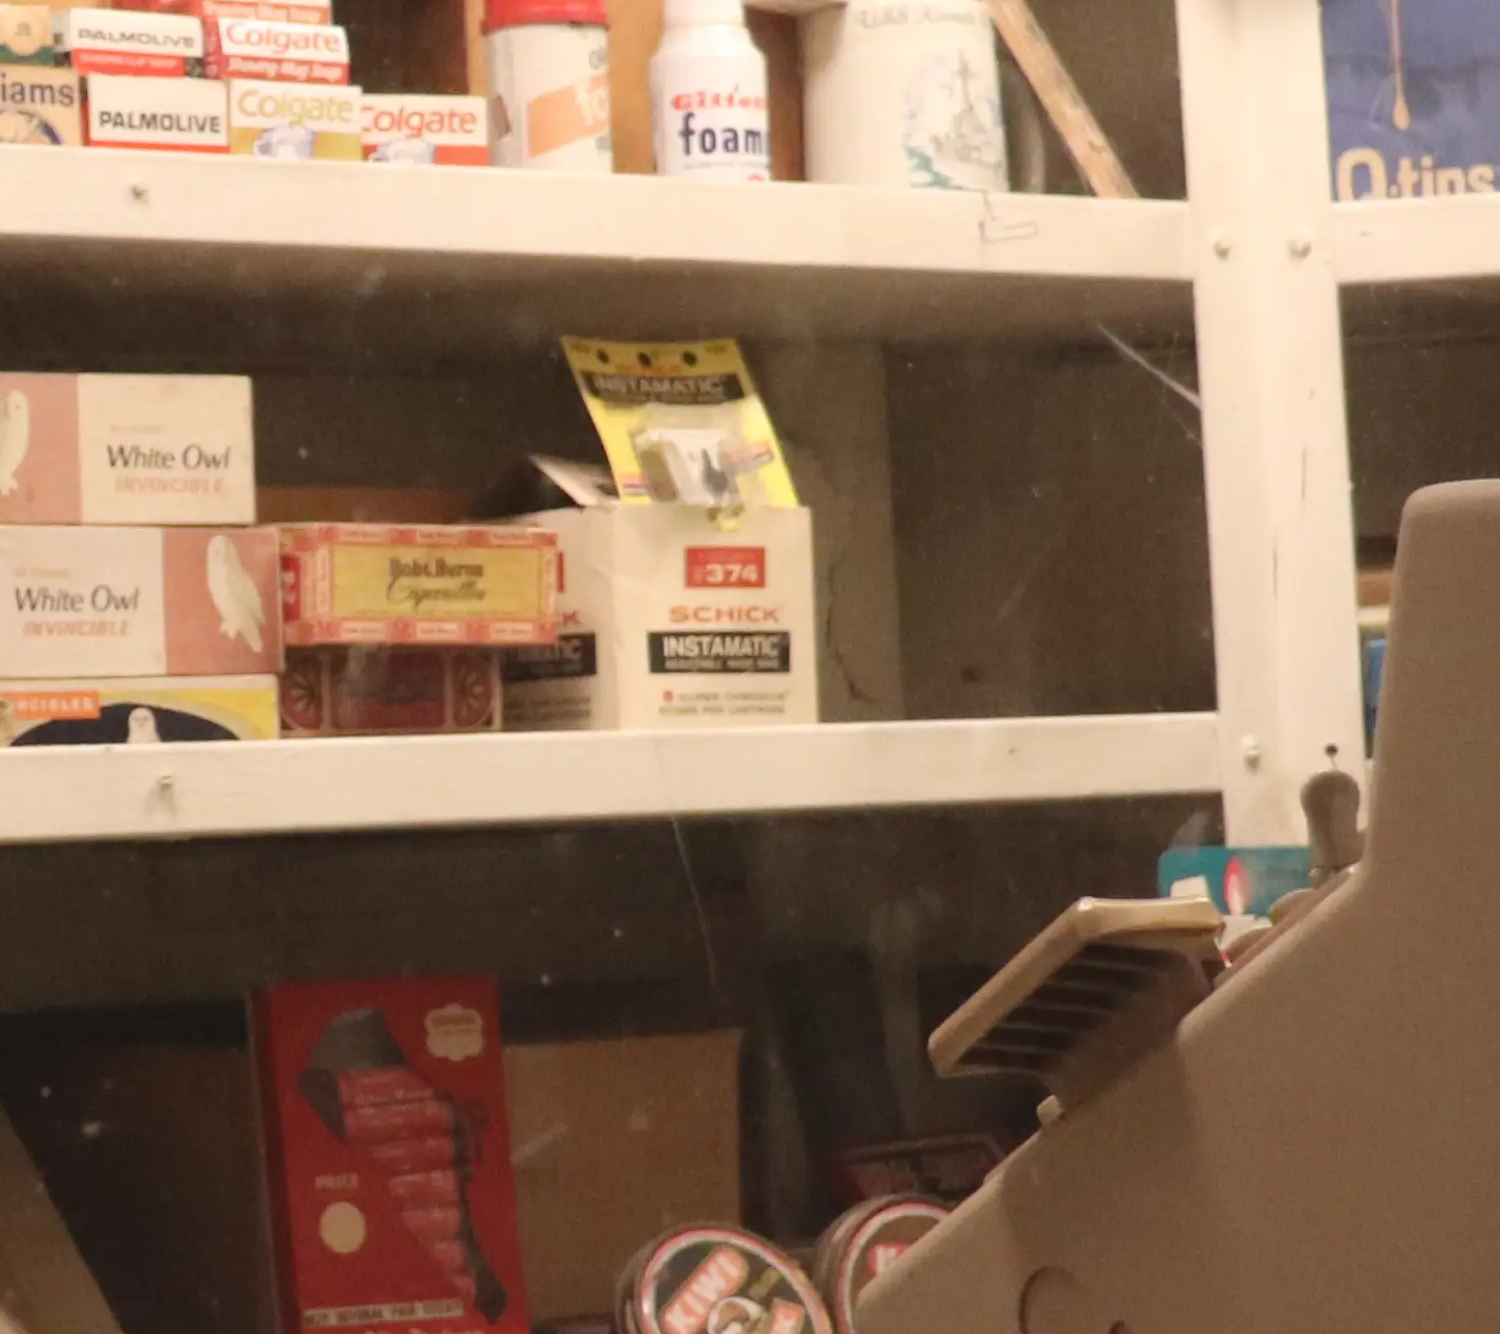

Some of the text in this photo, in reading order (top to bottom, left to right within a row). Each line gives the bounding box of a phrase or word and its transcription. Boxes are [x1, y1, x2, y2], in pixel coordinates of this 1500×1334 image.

[76, 26, 196, 49] PALMOLIVE
[225, 22, 341, 57] Colgate
[236, 88, 354, 126] Colgate
[99, 109, 222, 135] PALMOLIVE
[105, 443, 231, 471] White Owl
[14, 585, 141, 615] White Owl
[669, 604, 780, 624] SCHICK
[22, 619, 130, 638] INVINCIBLE
[662, 634, 780, 659] INSTAMATIC
